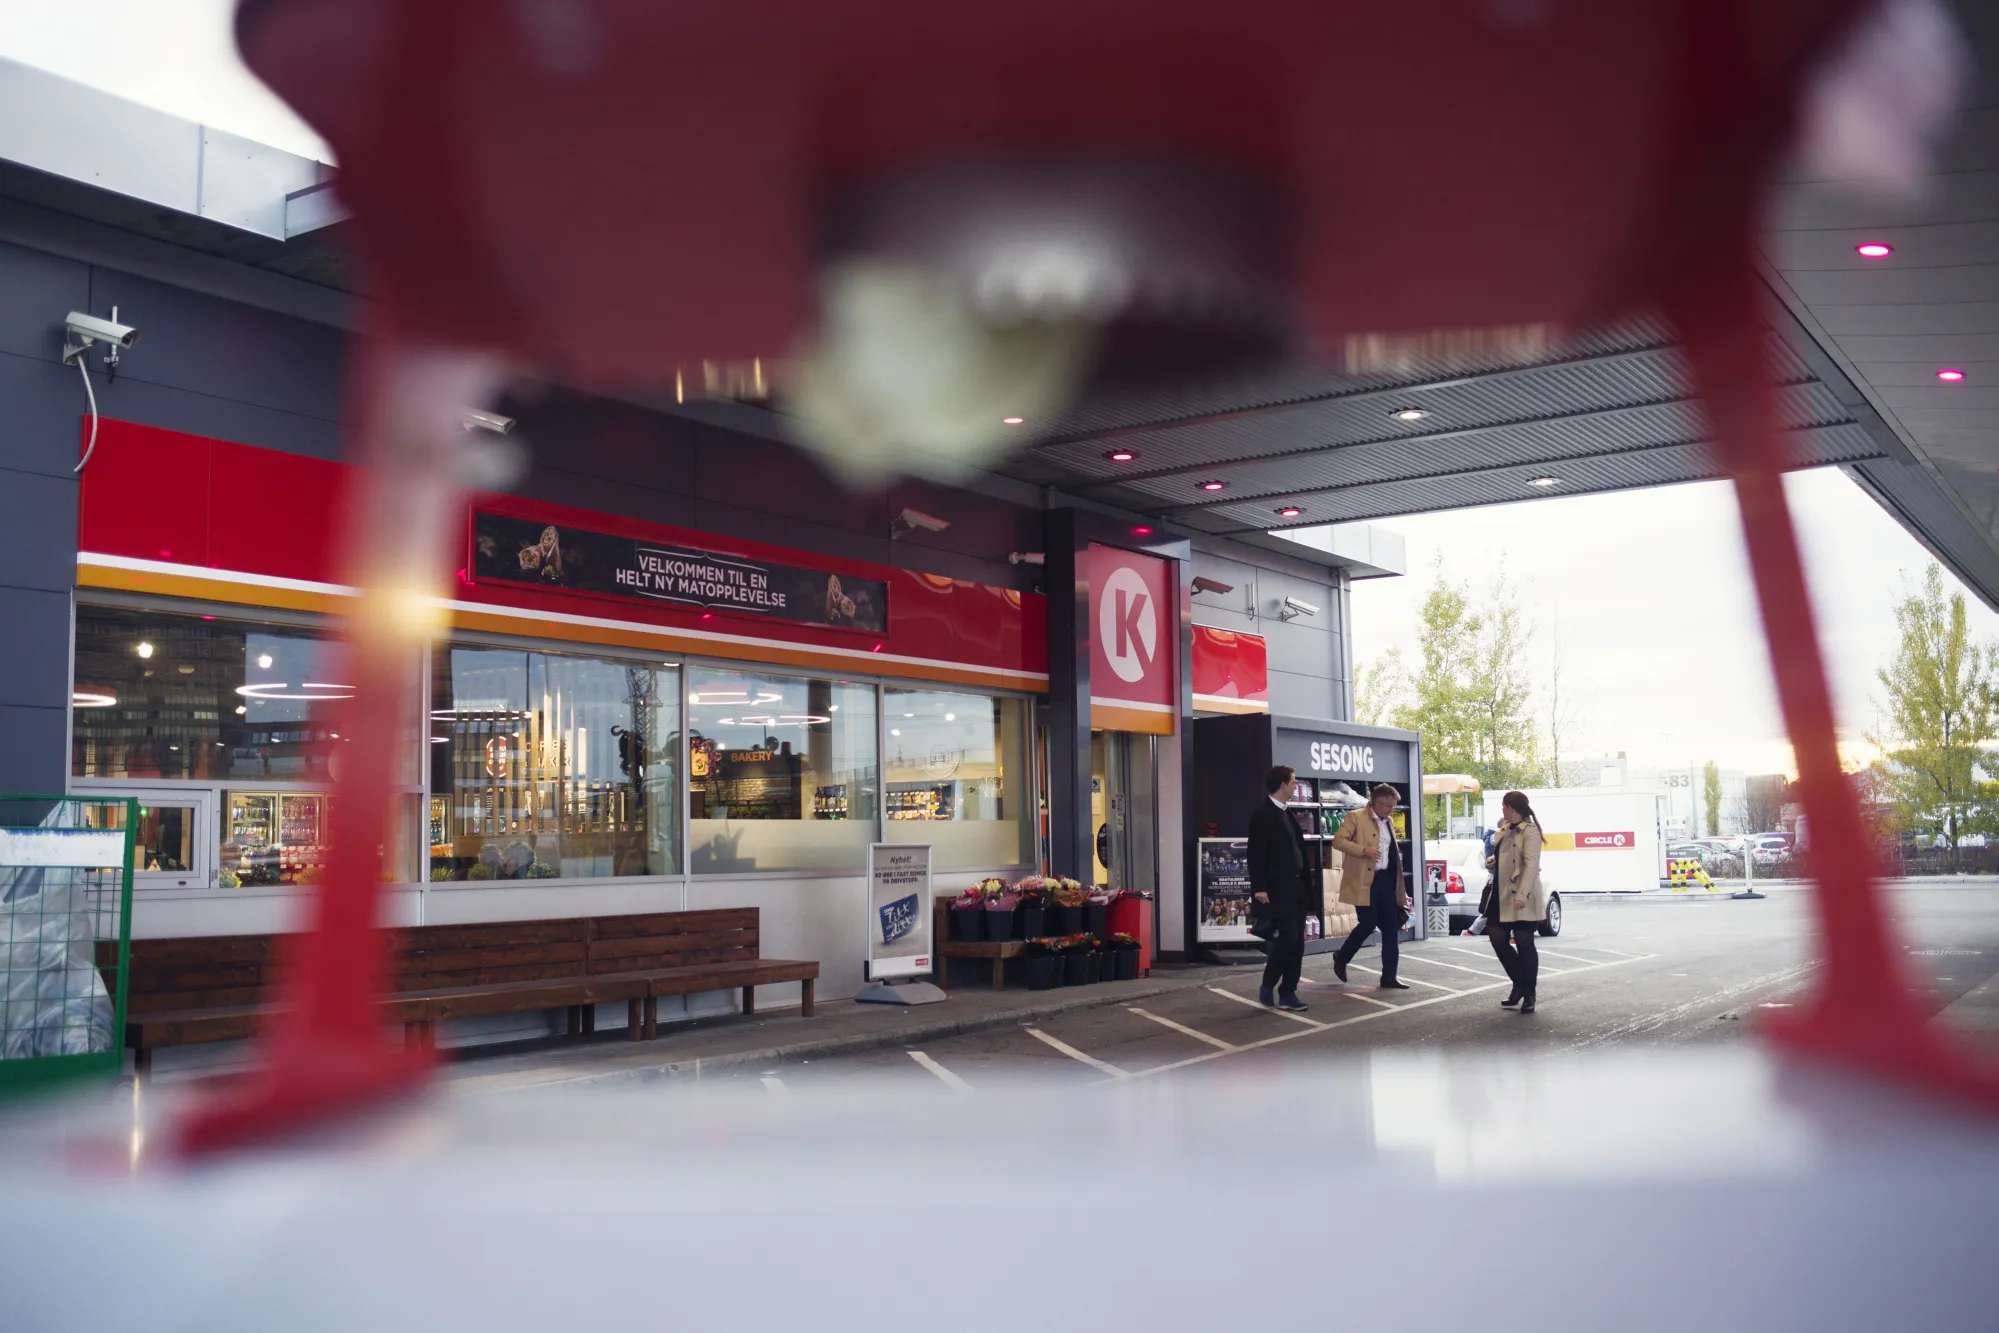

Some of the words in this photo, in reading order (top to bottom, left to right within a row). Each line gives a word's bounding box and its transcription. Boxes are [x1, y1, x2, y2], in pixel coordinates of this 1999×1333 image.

[616, 568, 651, 588] HELT
[655, 575, 674, 591] NY
[678, 579, 786, 607] MATOPPLEVELSE
[638, 555, 724, 582] VELKOMMEN
[727, 570, 747, 586] TIL
[750, 574, 767, 589] EN
[1111, 581, 1154, 679] K
[731, 750, 772, 763] BAKERY
[1310, 741, 1374, 774] SESONG
[1670, 775, 1689, 788] 83
[1584, 836, 1612, 845] CIRCLE
[1613, 834, 1625, 846] K
